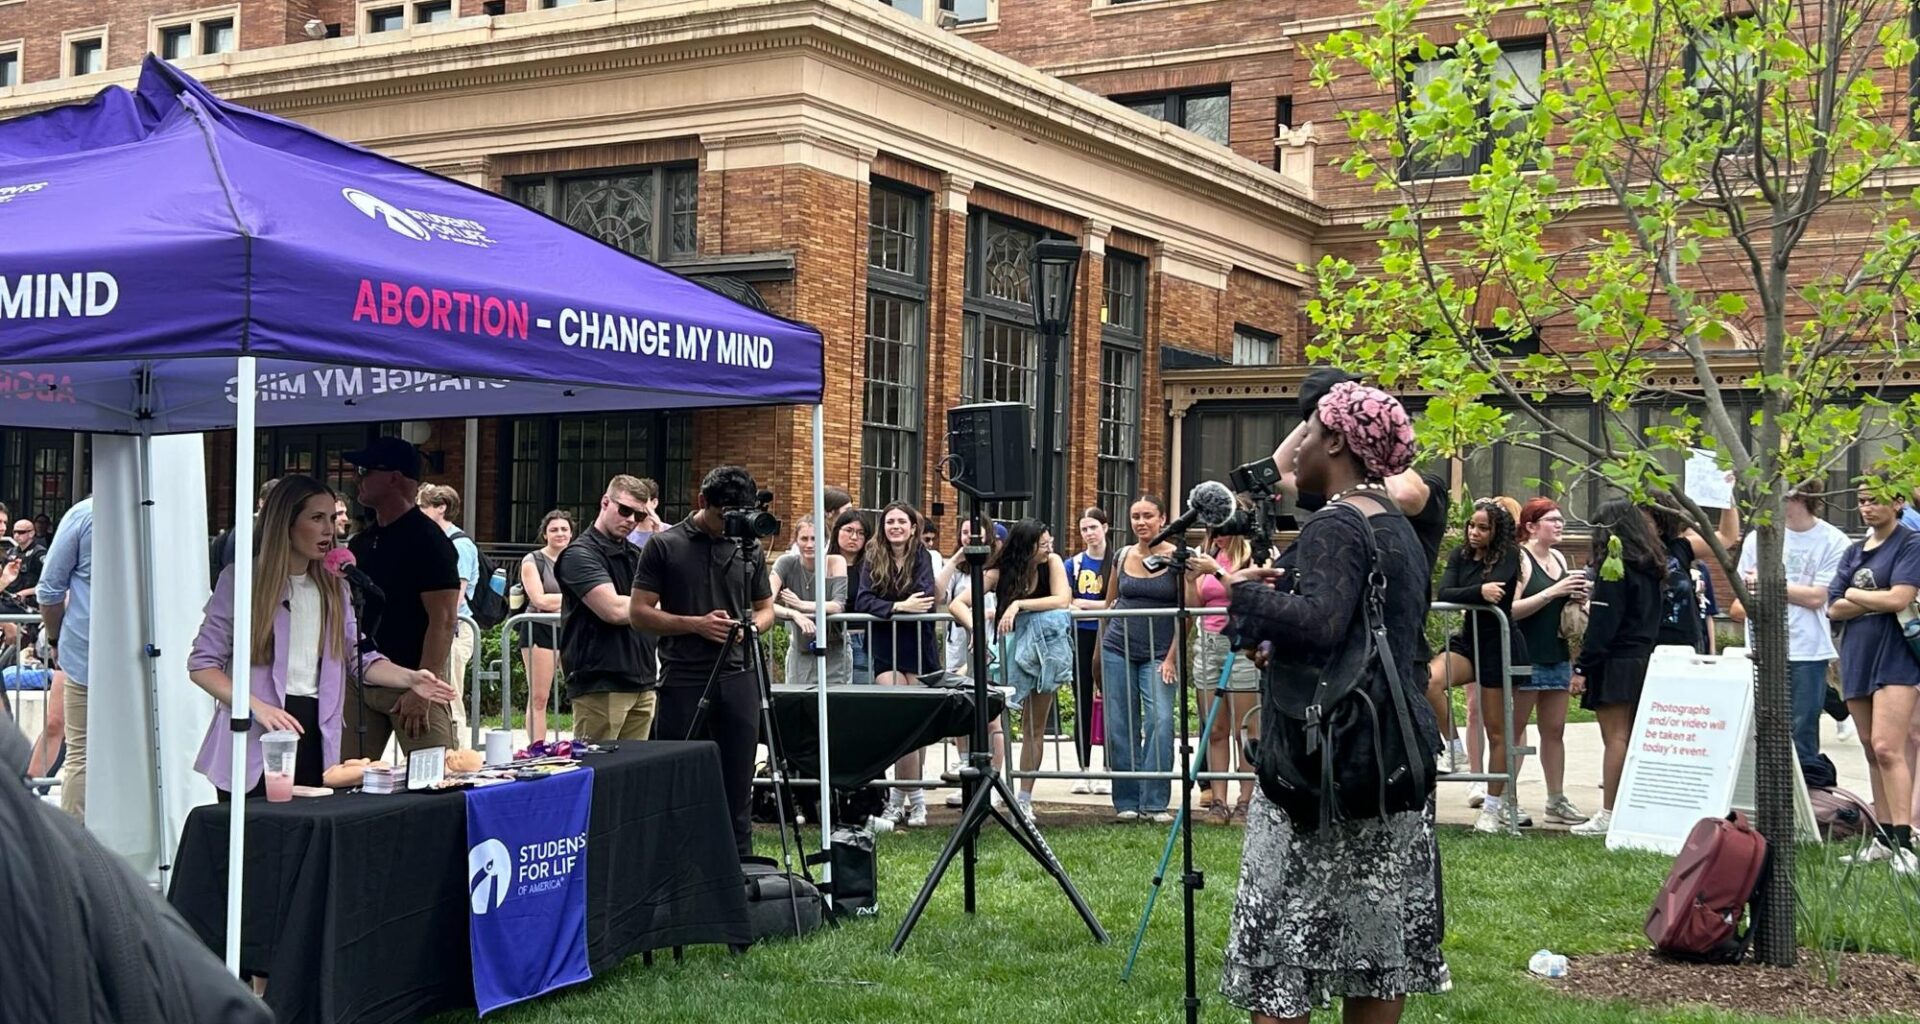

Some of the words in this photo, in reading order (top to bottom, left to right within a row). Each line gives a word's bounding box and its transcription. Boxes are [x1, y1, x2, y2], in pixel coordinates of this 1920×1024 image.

[0, 271, 119, 319] MIND
[352, 278, 529, 341] ABORTION
[537, 318, 552, 329] -
[558, 308, 670, 358] CHANGE
[675, 324, 712, 363] MY
[716, 330, 774, 370] MIND
[1651, 702, 1711, 715] Photographs
[1647, 716, 1680, 727] and/or
[1681, 718, 1708, 729] video
[1709, 720, 1727, 730] will
[1645, 729, 1657, 739] be
[1659, 730, 1685, 742] taken
[1686, 733, 1696, 742] at
[1642, 743, 1677, 756] today's
[519, 832, 586, 863] STUDENS
[519, 861, 550, 883] FOR
[518, 885, 528, 896] OF
